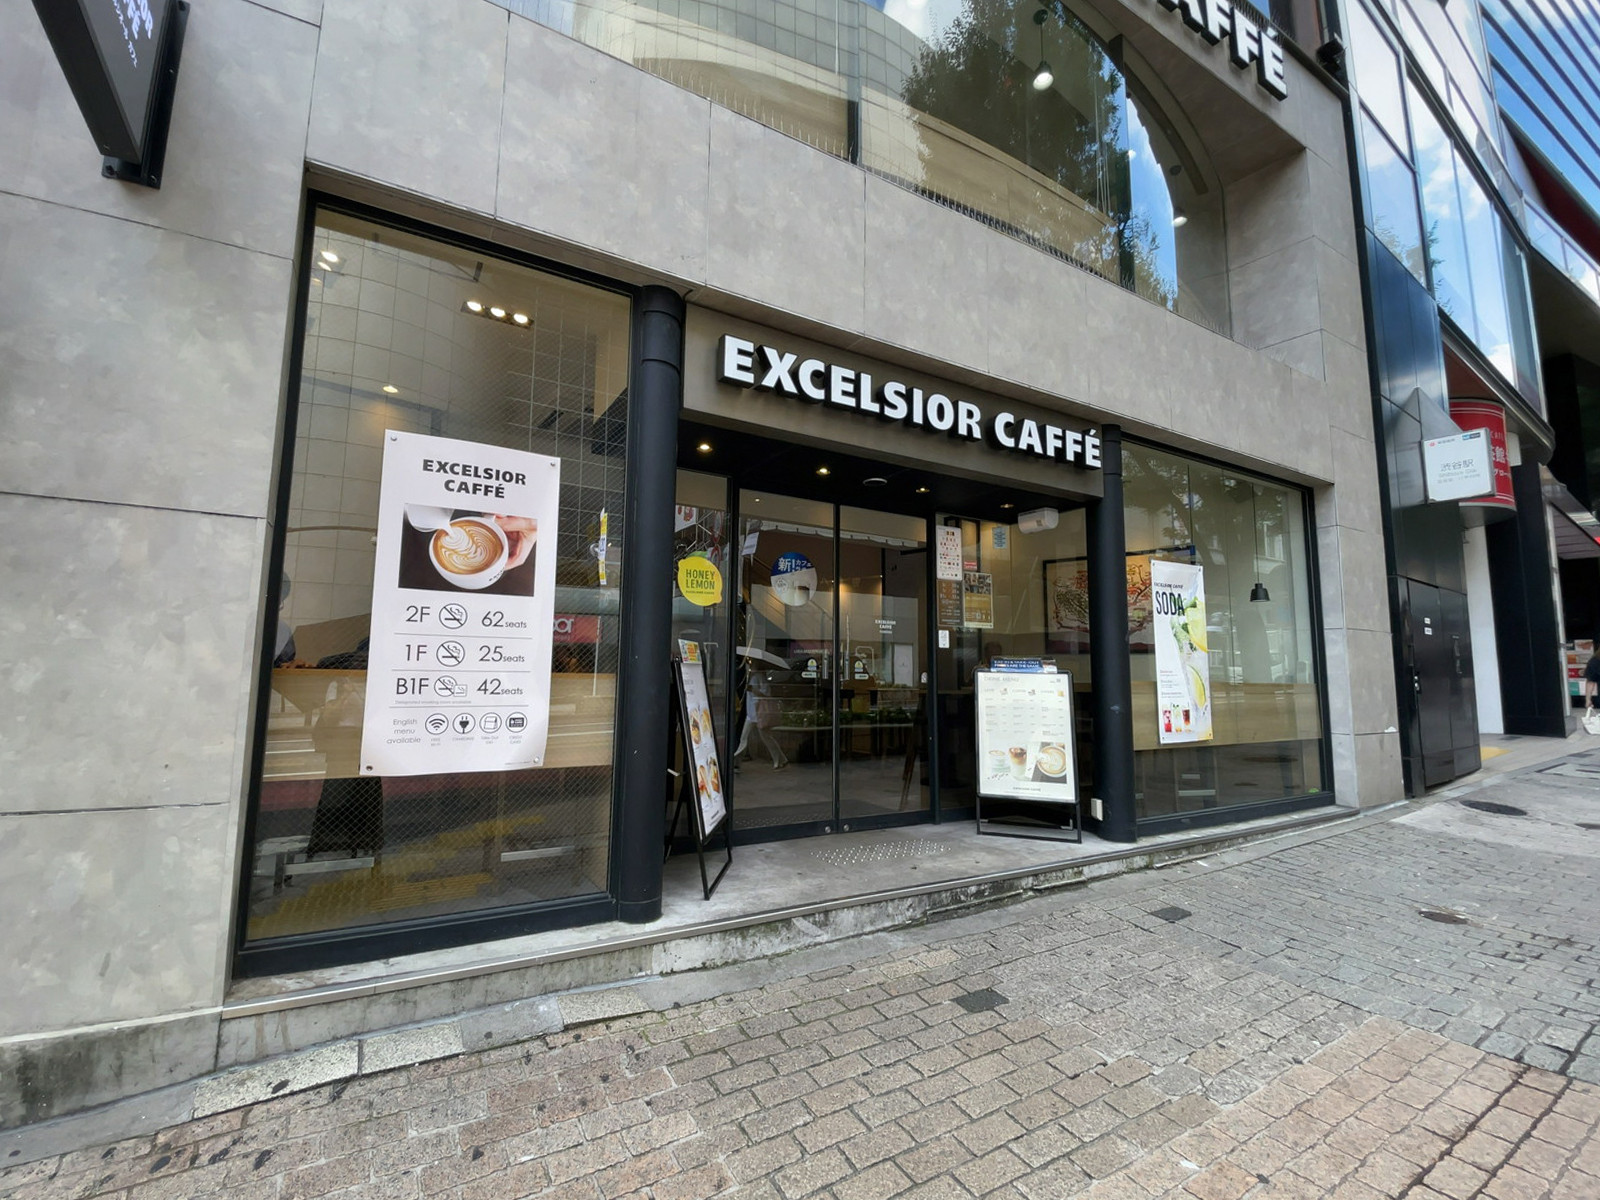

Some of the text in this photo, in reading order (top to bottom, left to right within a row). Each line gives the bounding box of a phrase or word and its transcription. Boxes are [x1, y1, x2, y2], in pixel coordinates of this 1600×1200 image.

[722, 334, 1102, 468] EXCELSIOR CAFFÉ
[422, 459, 526, 485] EXCELSIOR
[444, 479, 505, 498] CAFFÉ
[686, 569, 715, 580] HONEY
[686, 579, 715, 590] LEMON
[1155, 590, 1186, 616] SODA
[406, 605, 431, 623] 2F
[405, 644, 428, 662] 1F
[396, 678, 429, 695] B1F
[393, 719, 418, 727] English
[386, 737, 422, 745] available
